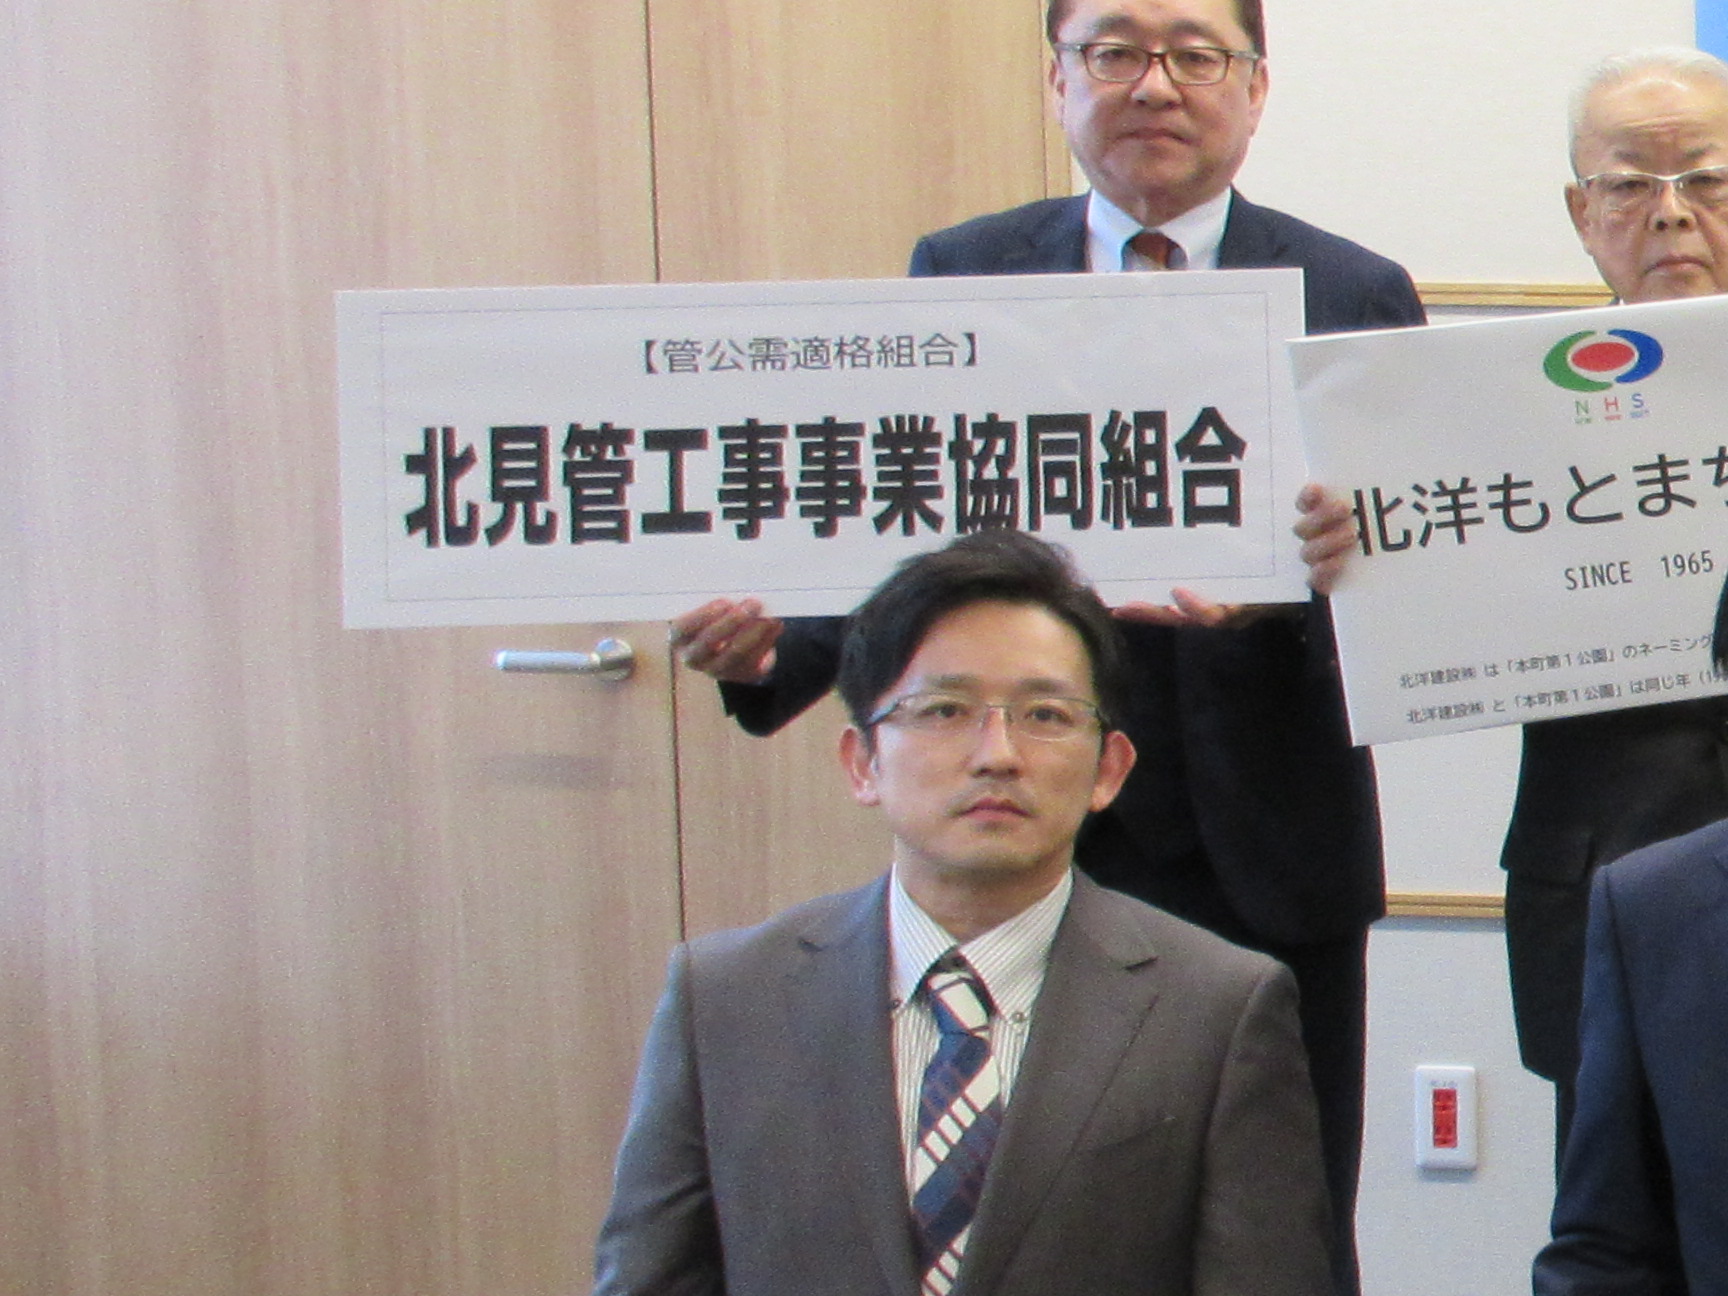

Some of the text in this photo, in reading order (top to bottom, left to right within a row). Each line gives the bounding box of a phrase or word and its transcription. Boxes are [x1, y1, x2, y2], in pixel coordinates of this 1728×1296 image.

[403, 405, 1249, 548] 北見管工事事業協同組合
[1563, 549, 1715, 593] SINCE 1965
